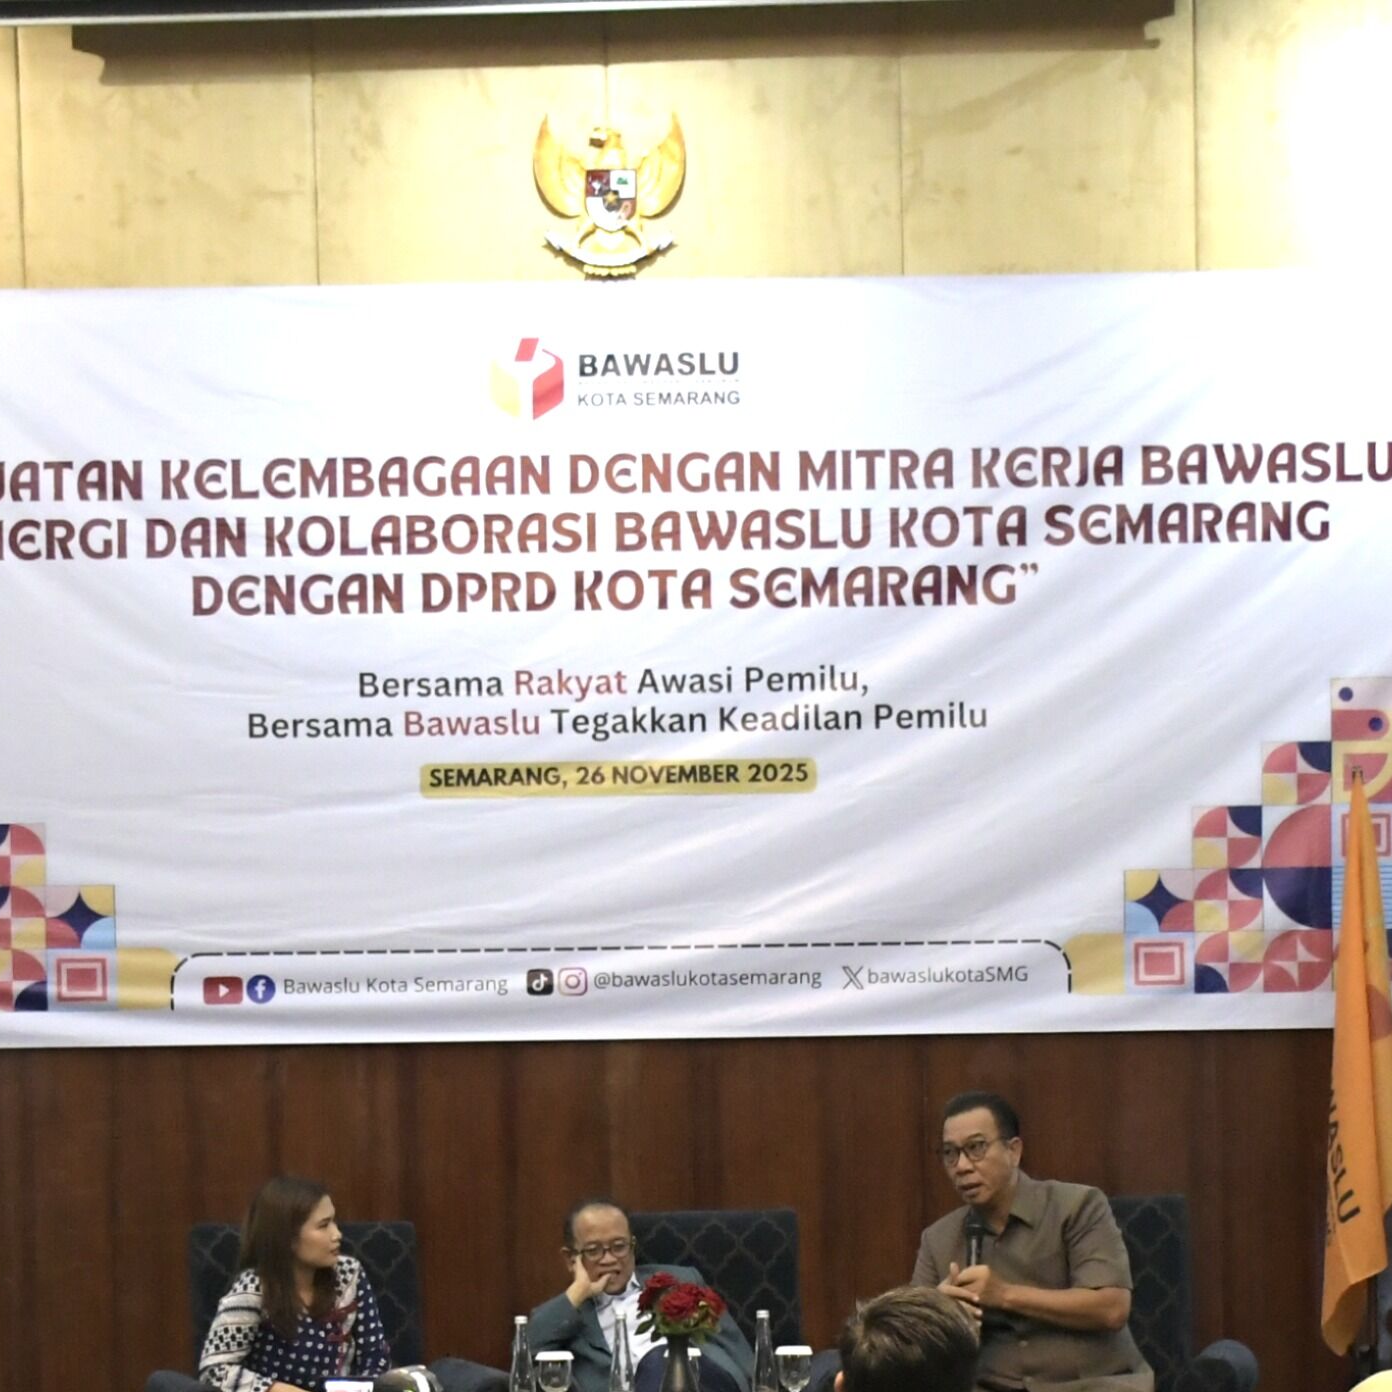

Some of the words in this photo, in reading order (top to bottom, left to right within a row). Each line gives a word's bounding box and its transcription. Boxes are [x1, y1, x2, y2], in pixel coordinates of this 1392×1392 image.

[578, 351, 739, 378] BAWASLU
[577, 392, 627, 407] KOTA
[633, 390, 741, 406] SEMARANG
[160, 454, 551, 501] KELEMBAGAAN
[569, 450, 781, 495] DENGAN
[798, 447, 954, 492] MITRA
[971, 444, 1124, 489] KERJA
[145, 516, 247, 559] DAN
[264, 512, 597, 558] KOLABORASI
[615, 507, 872, 553] BAWASLU
[889, 504, 1028, 548] KOTA
[1043, 500, 1330, 547] SEMARANG
[191, 572, 404, 617] DENGAN
[421, 571, 557, 614] DPRD
[574, 567, 712, 612] KOTA
[729, 562, 1039, 610] SEMARANG”
[358, 671, 504, 699] Bersama
[514, 668, 628, 703] Rakyat
[637, 665, 733, 695] Awasi
[745, 664, 869, 697] Pemilu,
[248, 712, 394, 739] Bersama
[404, 708, 540, 737] Bawaslu
[549, 706, 707, 742] Tegakkan
[718, 704, 863, 732] Keadilan
[874, 701, 987, 730] Pemilu
[428, 765, 568, 789] SEMARANG,
[575, 765, 606, 786] 26
[611, 763, 741, 785] NOVEMBER
[747, 762, 809, 783] 2025
[282, 976, 360, 995] Bawaslu
[365, 975, 410, 993] Kota
[412, 974, 509, 997] Semarang
[593, 967, 823, 989] @bawaslukotasemarang
[866, 963, 1030, 986] bawaslukotaSMG
